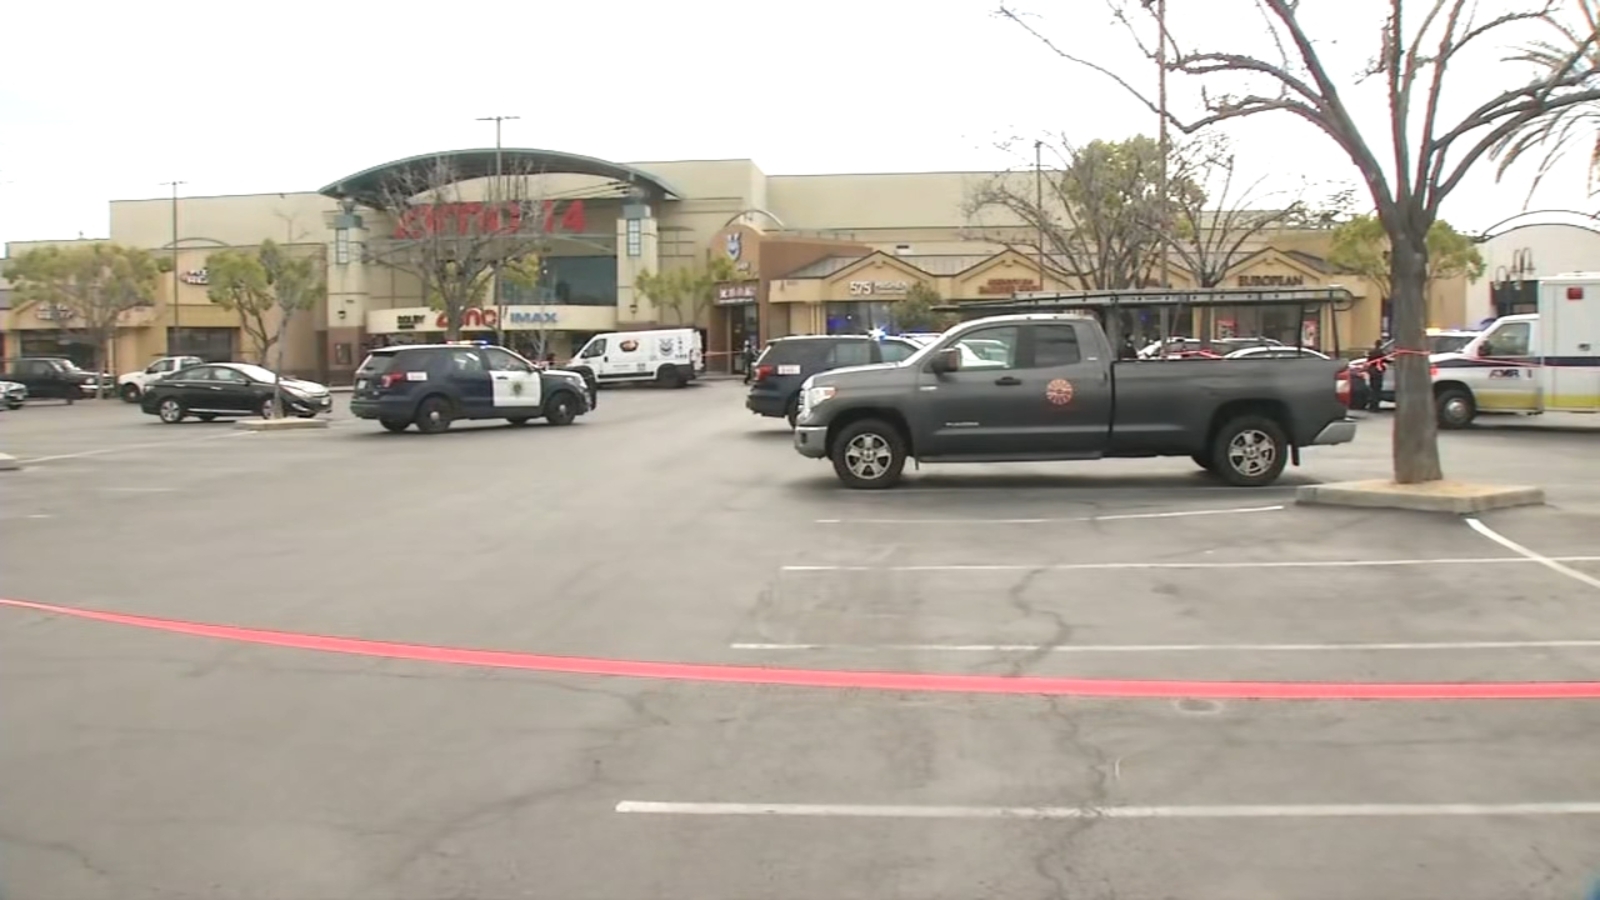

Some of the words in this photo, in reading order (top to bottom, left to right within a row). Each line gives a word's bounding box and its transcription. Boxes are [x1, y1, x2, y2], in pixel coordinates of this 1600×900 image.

[543, 198, 586, 233] 14
[1238, 275, 1304, 286] EUROPEAN
[511, 312, 559, 323] IMAX
